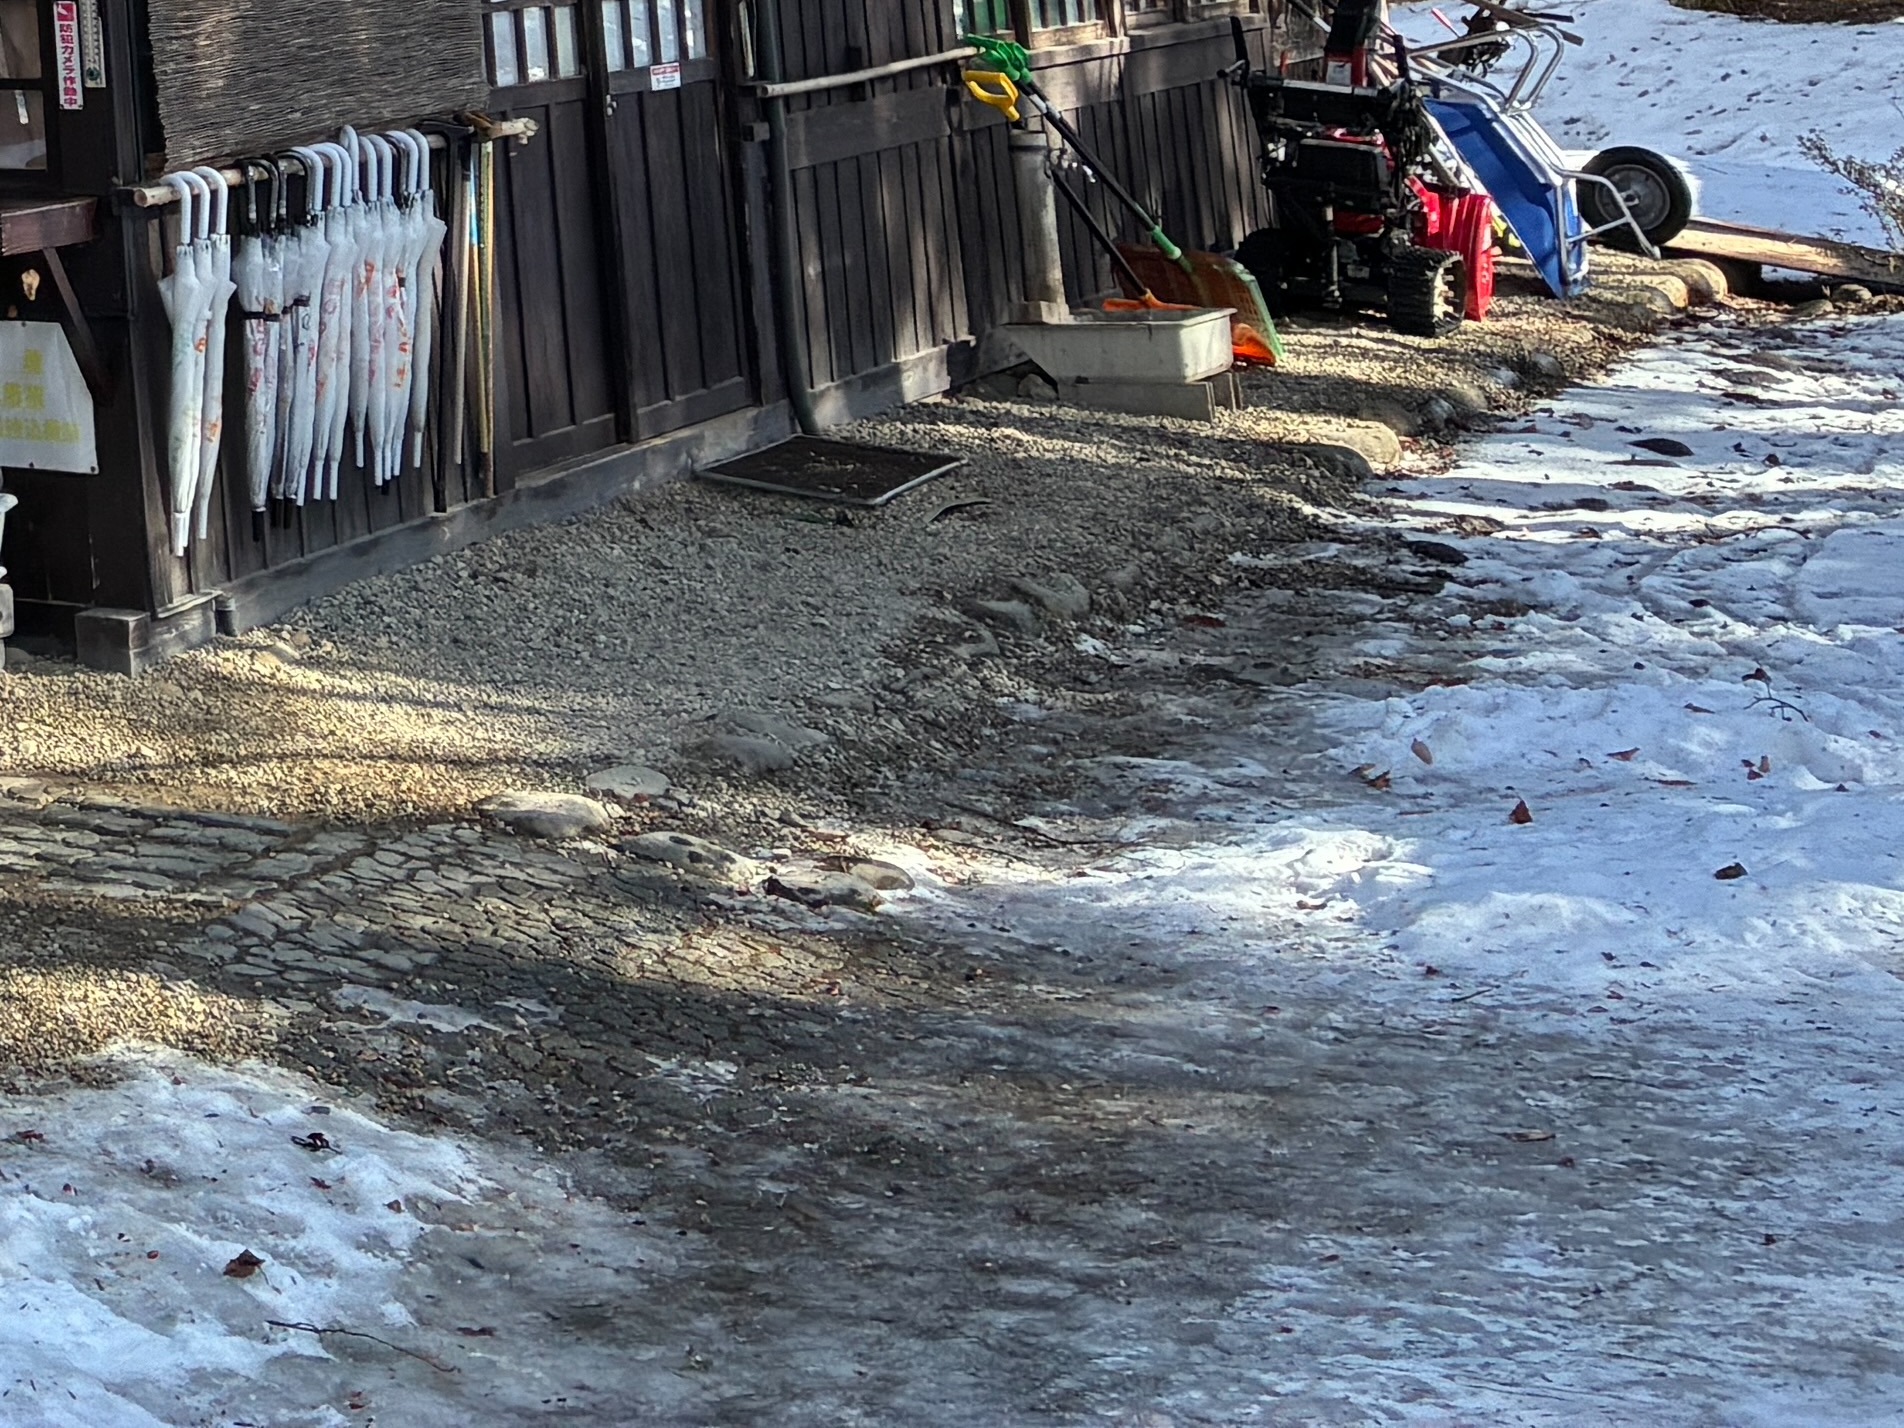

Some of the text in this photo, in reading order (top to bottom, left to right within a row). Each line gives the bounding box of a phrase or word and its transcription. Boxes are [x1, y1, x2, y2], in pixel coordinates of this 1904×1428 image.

[59, 23, 77, 107] 防犯カメラ作動中
